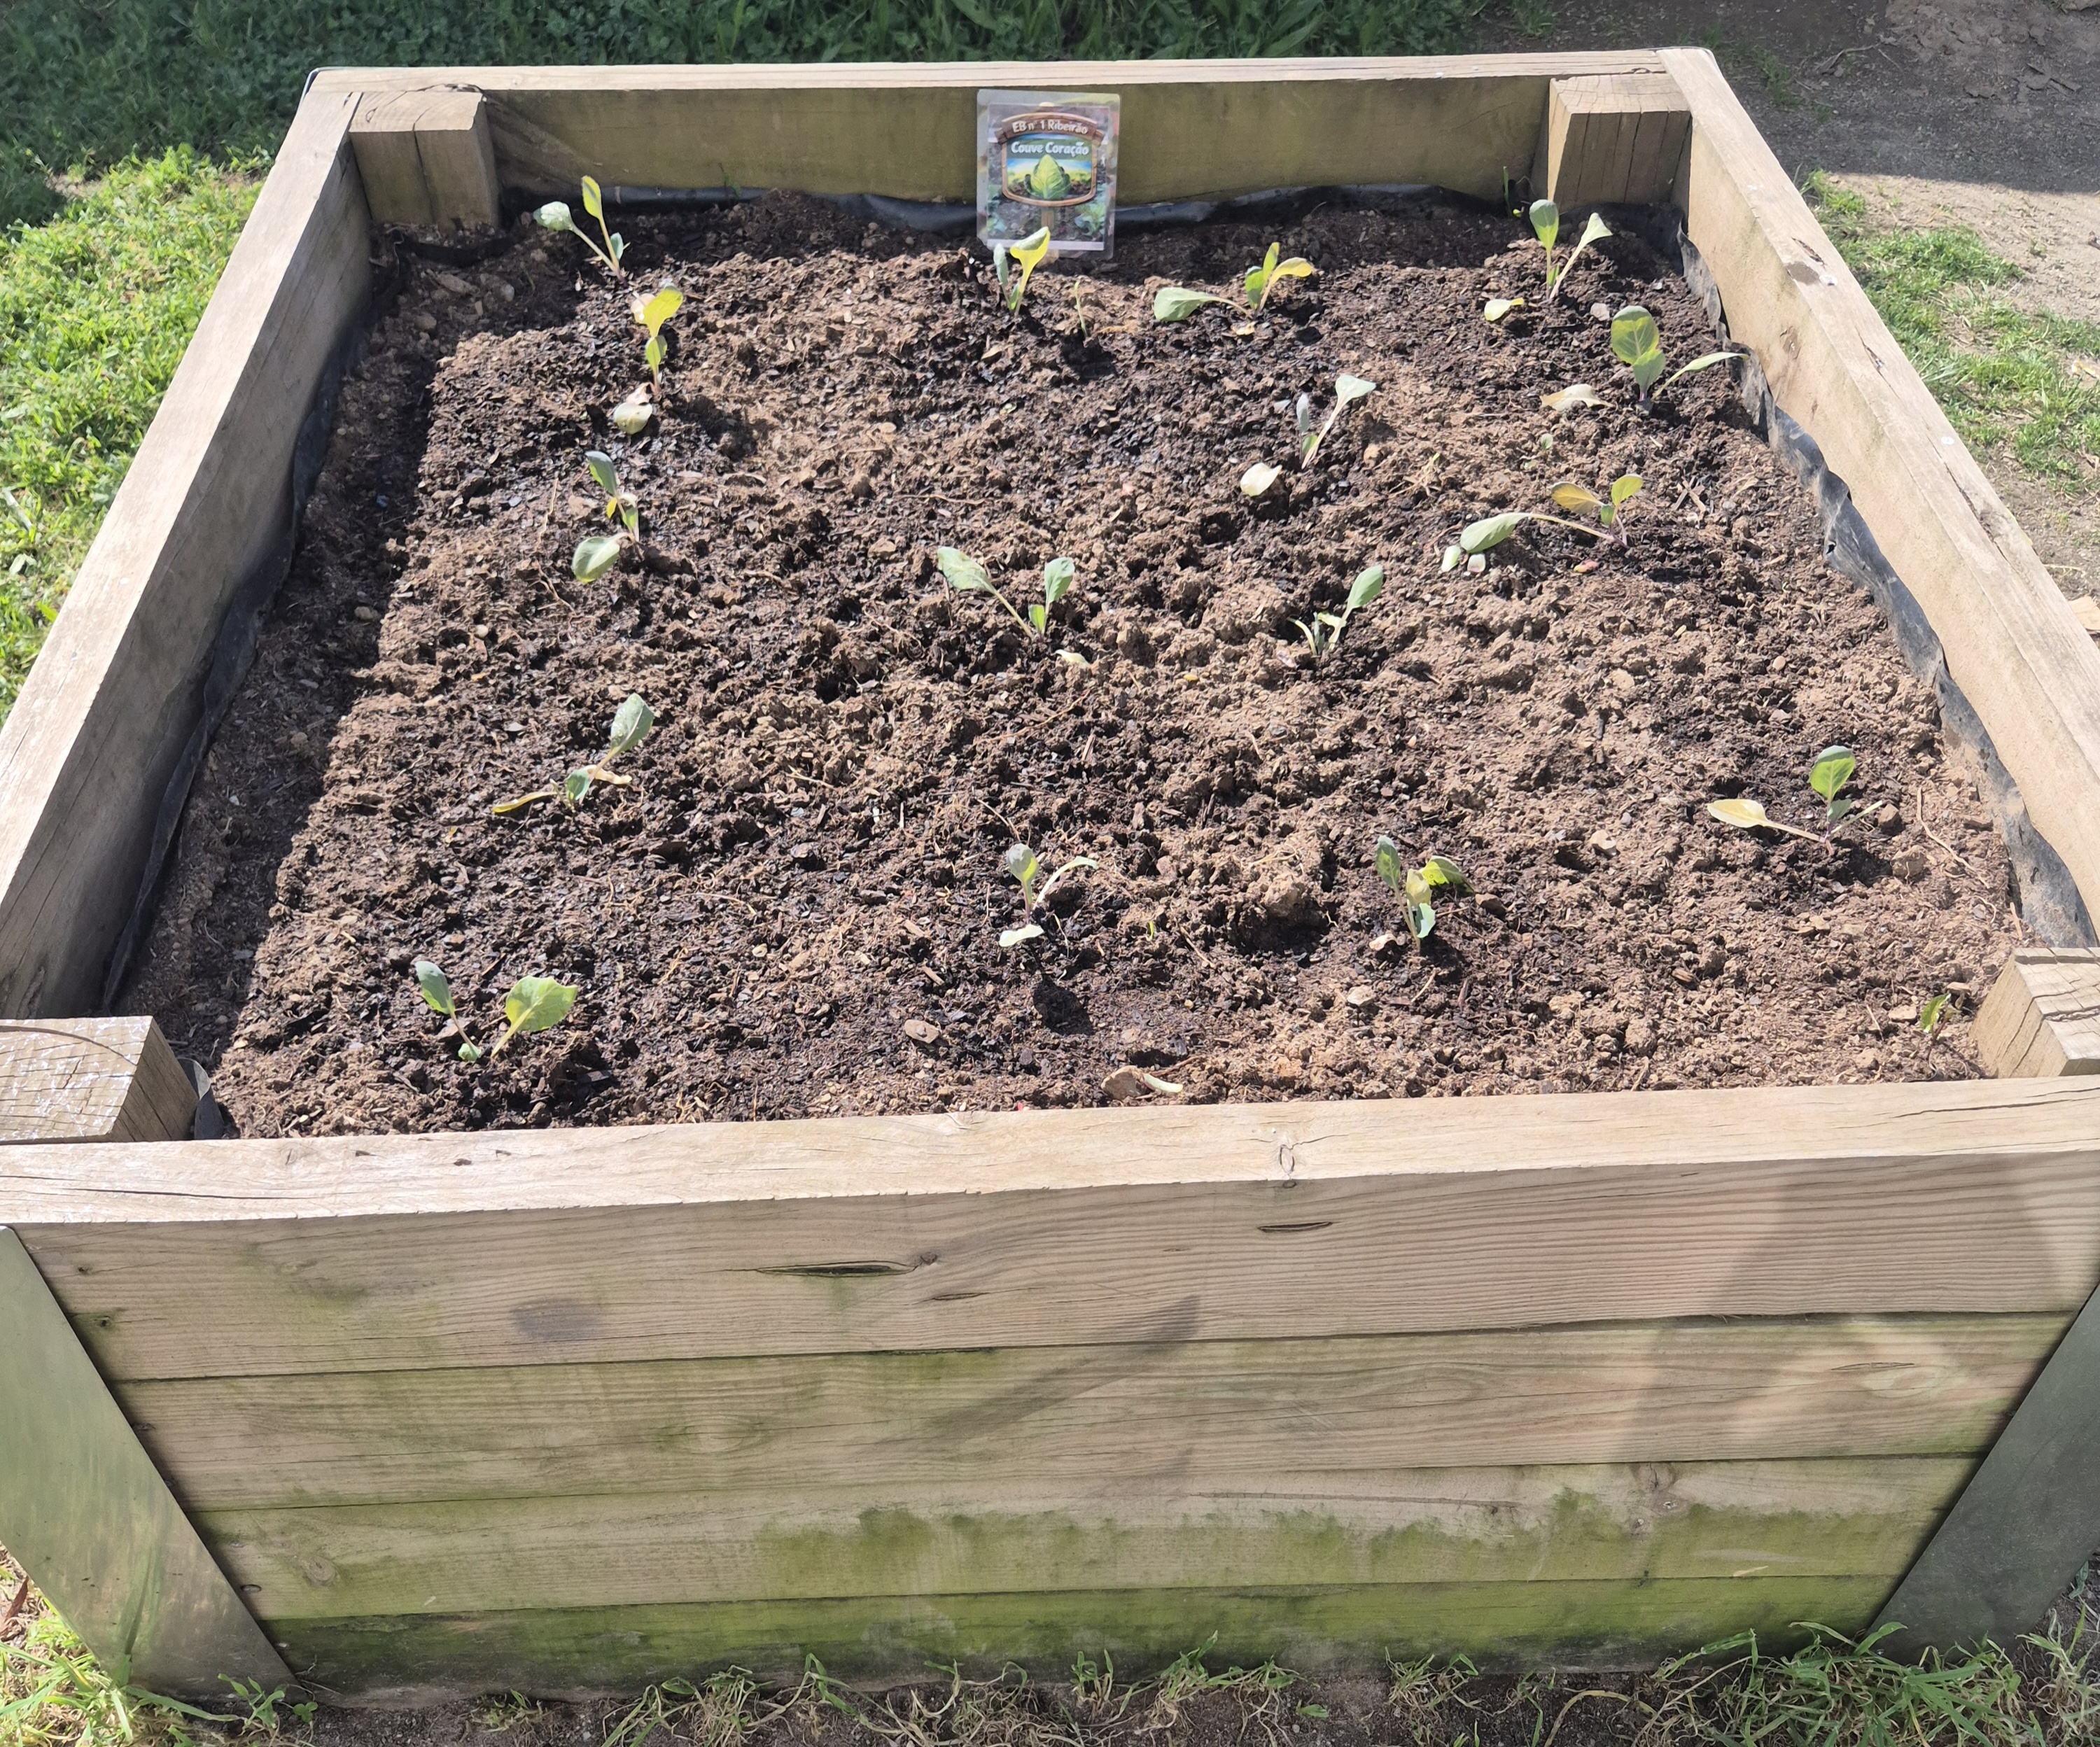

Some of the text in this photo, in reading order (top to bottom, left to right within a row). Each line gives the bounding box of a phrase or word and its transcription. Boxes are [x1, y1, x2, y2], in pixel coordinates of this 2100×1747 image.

[1012, 121, 1027, 133] EB
[1040, 120, 1045, 129] 1
[1048, 120, 1088, 134] Ribeirão
[1011, 141, 1089, 157] Couve Coração
